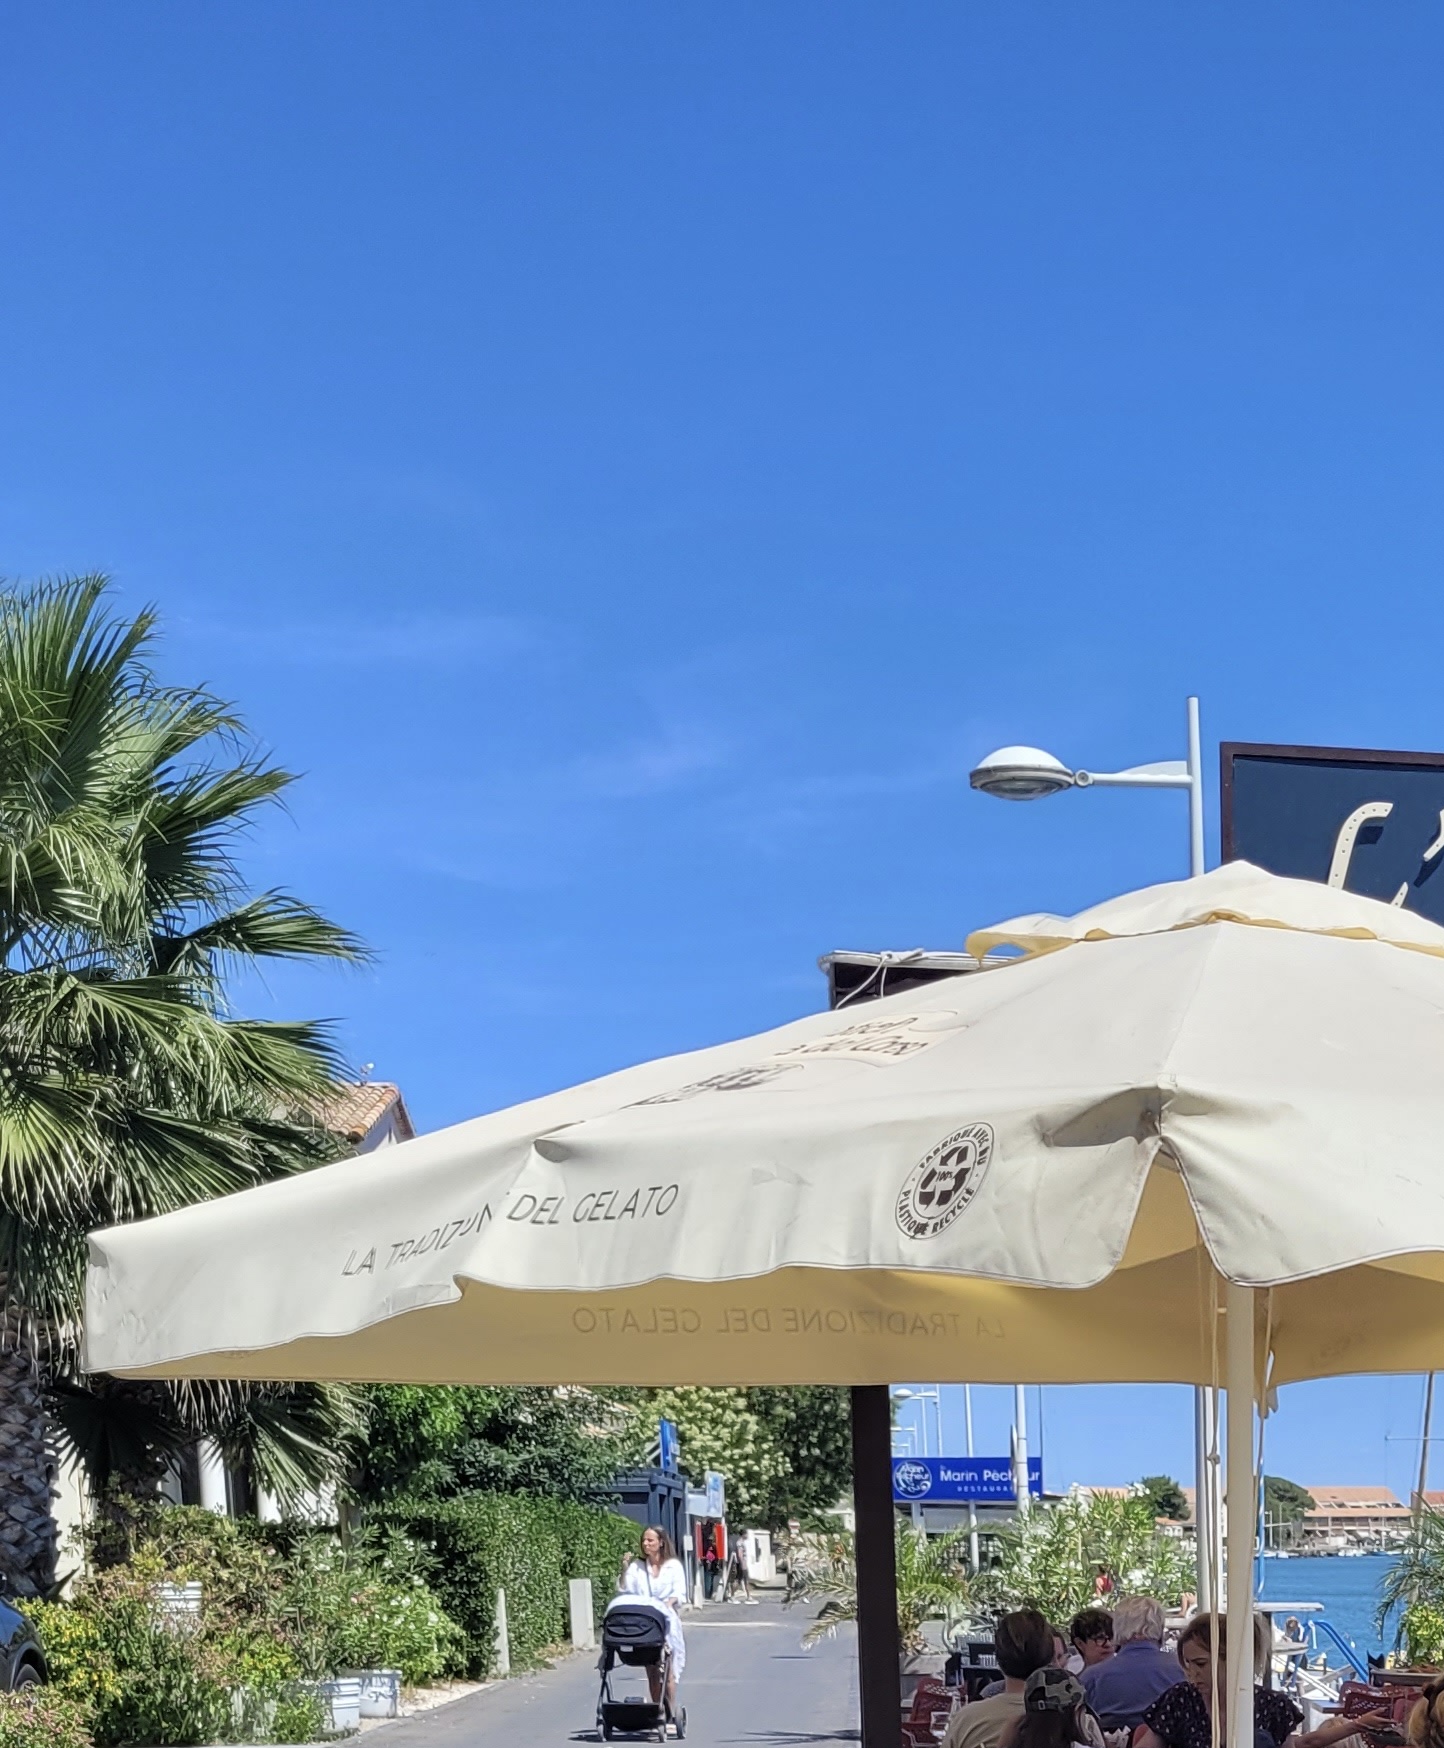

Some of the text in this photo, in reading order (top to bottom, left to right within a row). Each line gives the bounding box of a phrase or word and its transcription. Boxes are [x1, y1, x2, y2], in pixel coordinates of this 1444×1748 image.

[341, 1246, 377, 1277] LA
[506, 1194, 566, 1225] DEL
[572, 1183, 680, 1224] GELATO
[940, 1468, 1040, 1482] Marin Pêcur
[957, 1485, 1013, 1493] RESTAURA
